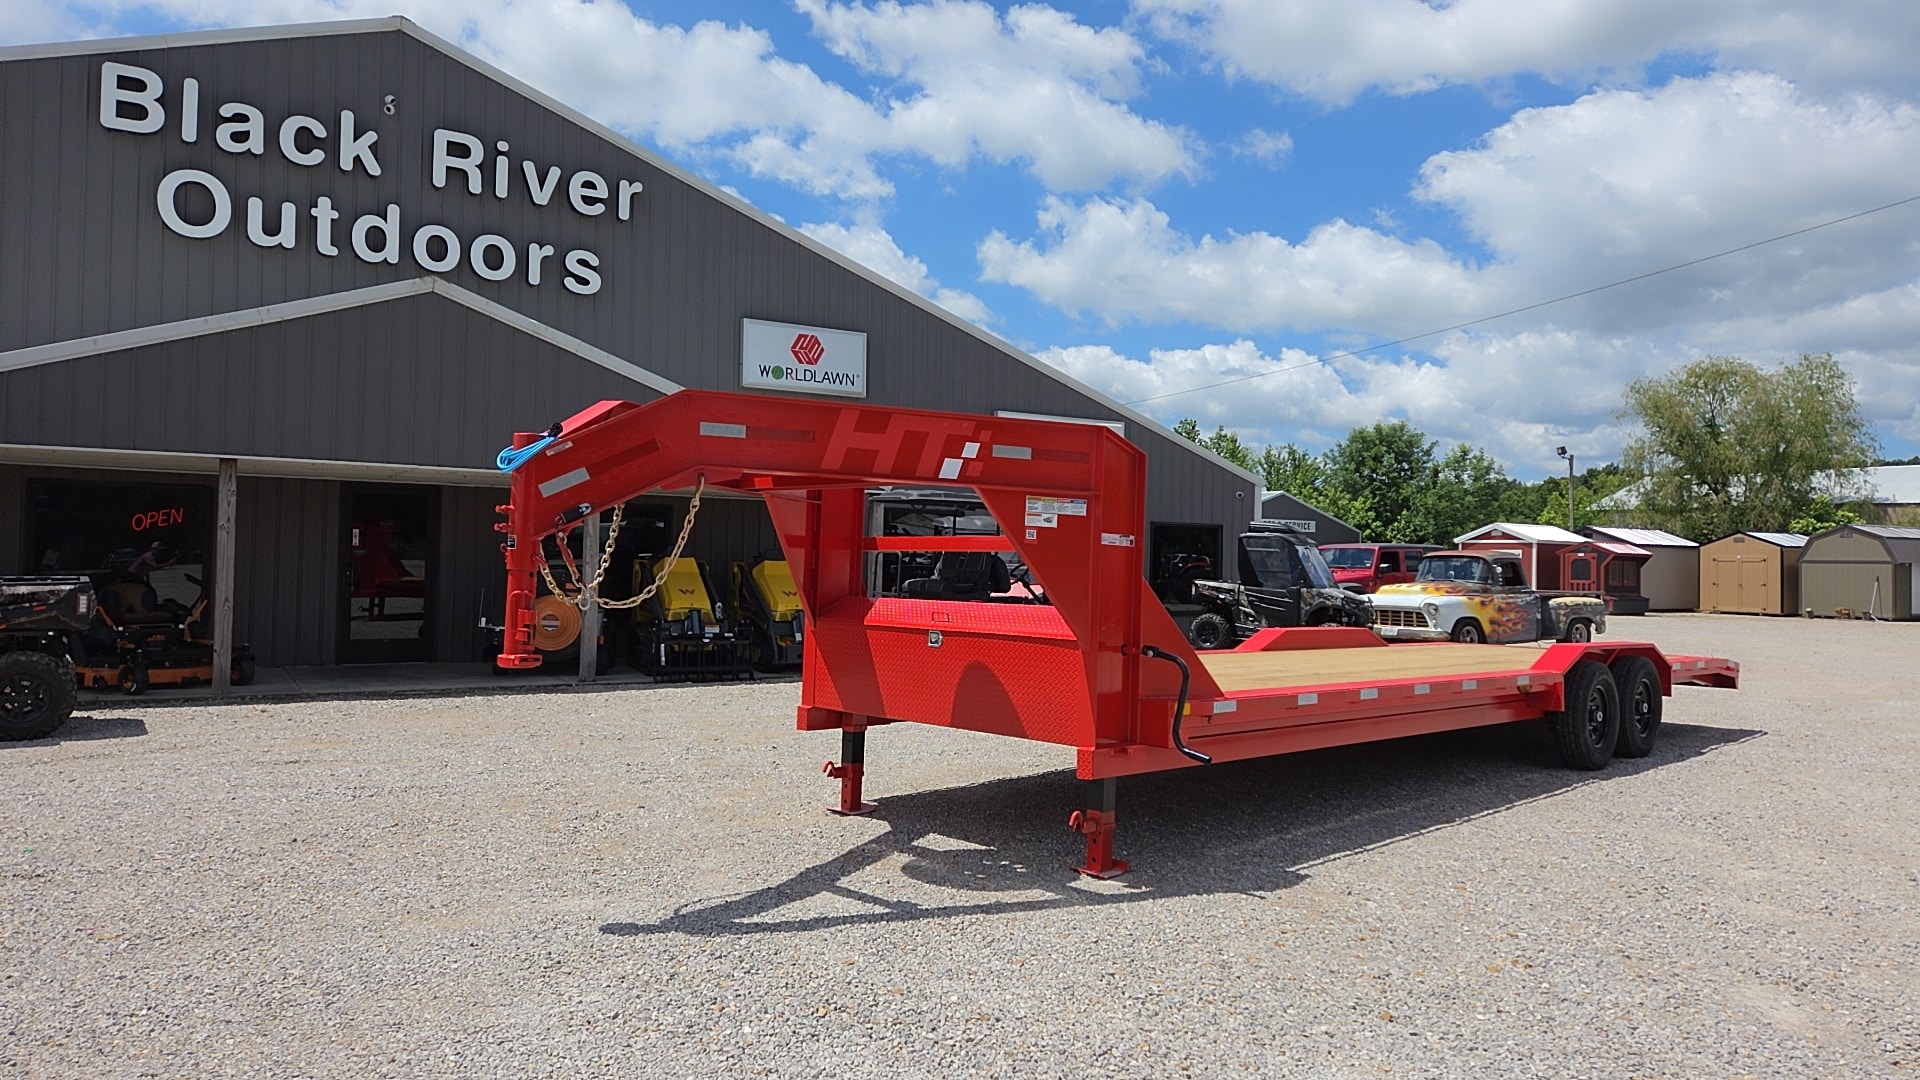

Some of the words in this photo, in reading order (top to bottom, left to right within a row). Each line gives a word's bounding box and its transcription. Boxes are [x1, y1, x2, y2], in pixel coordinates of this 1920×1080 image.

[100, 61, 381, 177] Black
[432, 128, 643, 221] River
[157, 168, 603, 295] Outdoors
[758, 364, 855, 387] WORLDLAWN
[132, 507, 183, 531] OPEN
